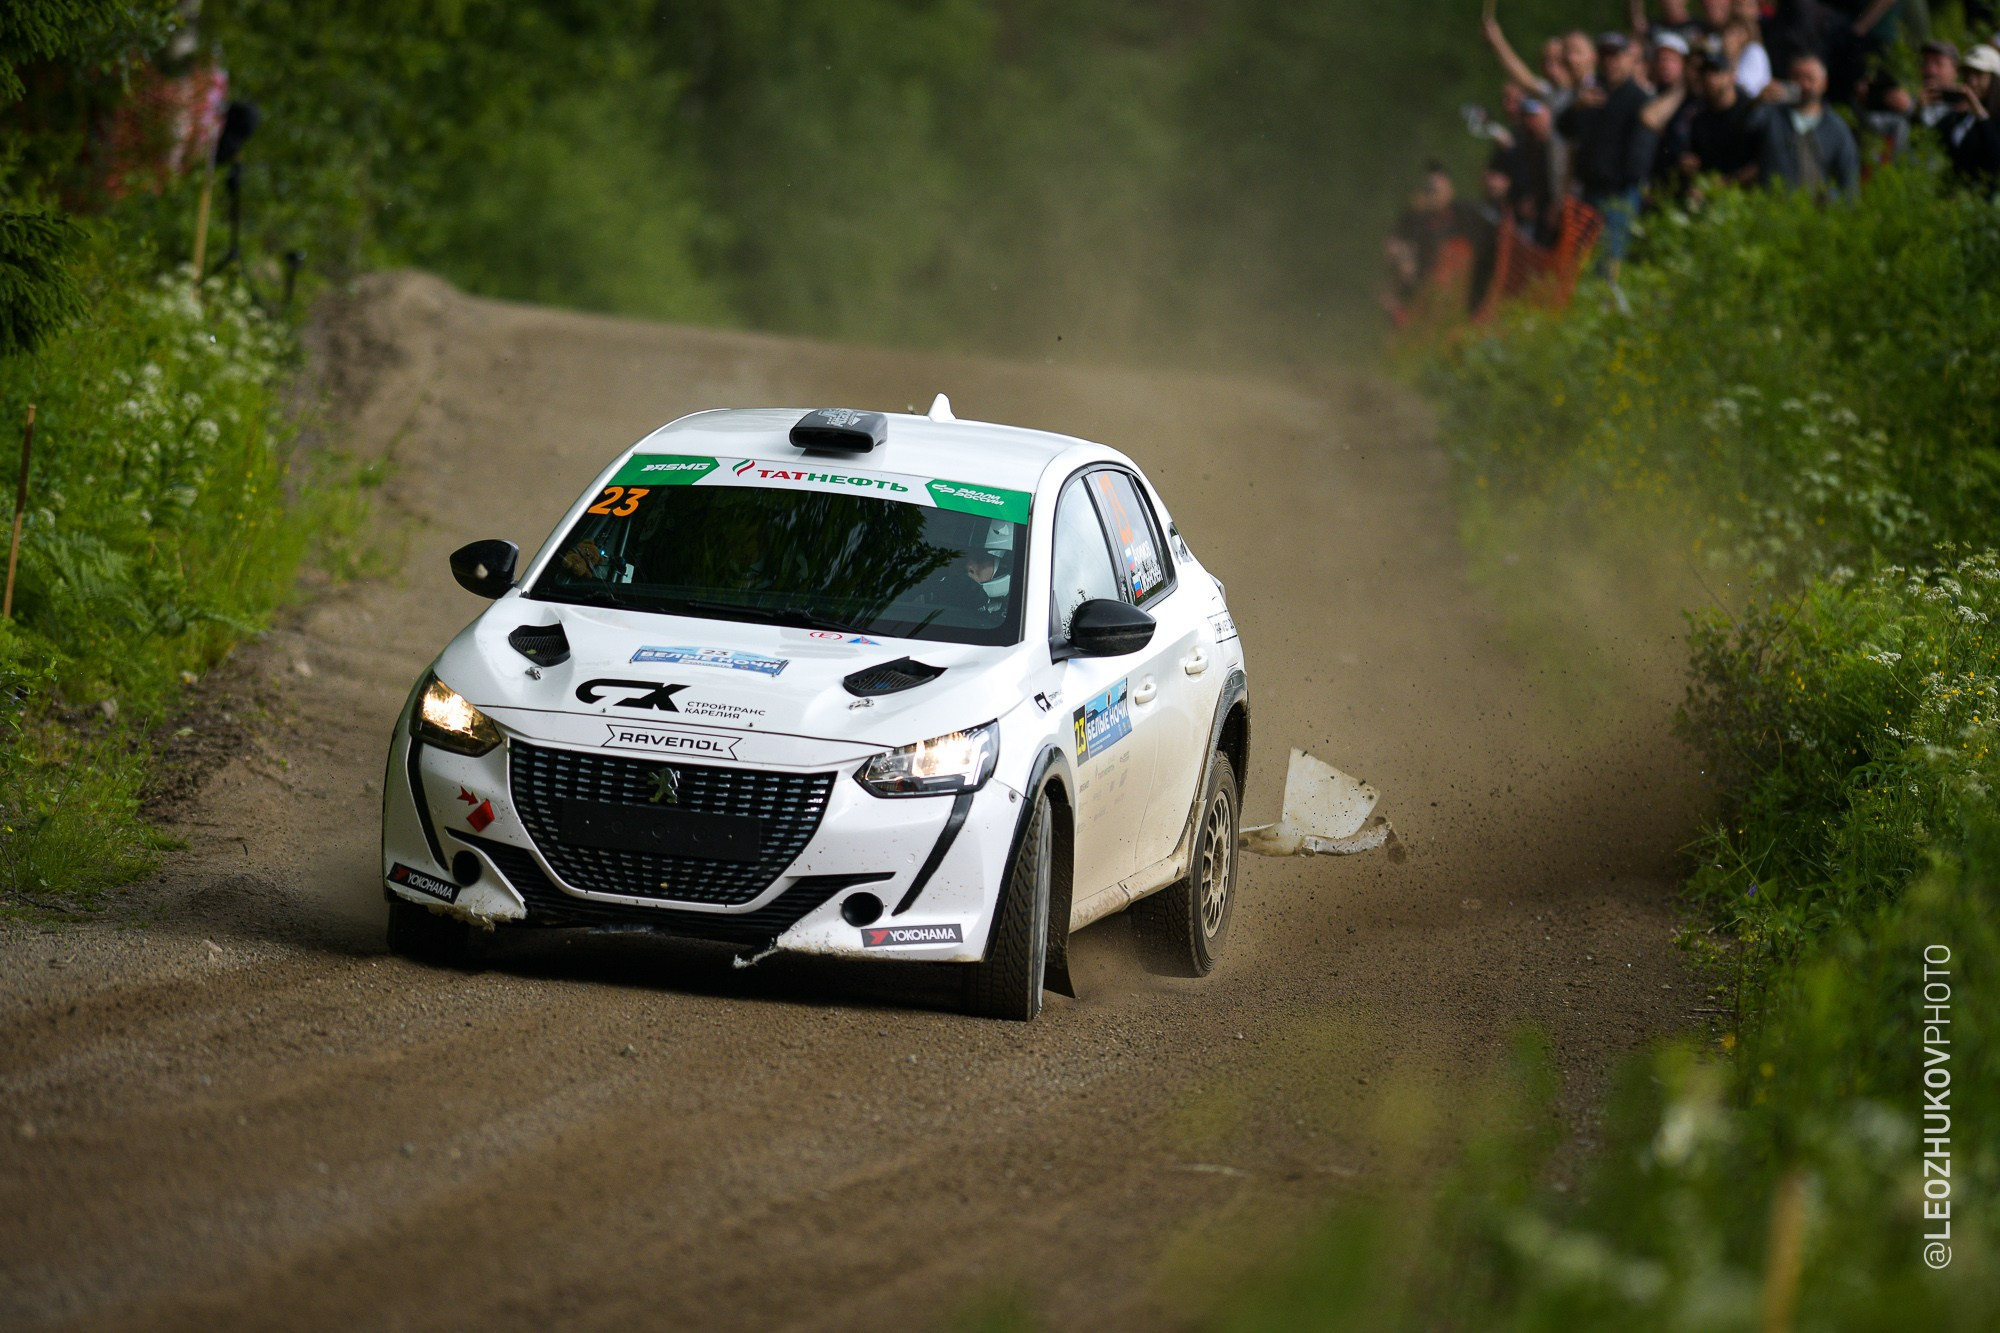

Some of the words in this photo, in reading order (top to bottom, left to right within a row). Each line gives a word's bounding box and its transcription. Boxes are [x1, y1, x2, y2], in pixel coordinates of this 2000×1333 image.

[757, 469, 909, 493] ТАТНЕФТЬ
[587, 486, 650, 517] 23
[684, 708, 740, 720] КАРЕЛИЯ
[687, 701, 766, 717] СТРОЙТРАНС
[619, 732, 724, 752] RAVENOL
[1074, 717, 1087, 756] 23
[407, 872, 453, 899] YOKOHAMA
[889, 928, 957, 942] YOKOHAMA
